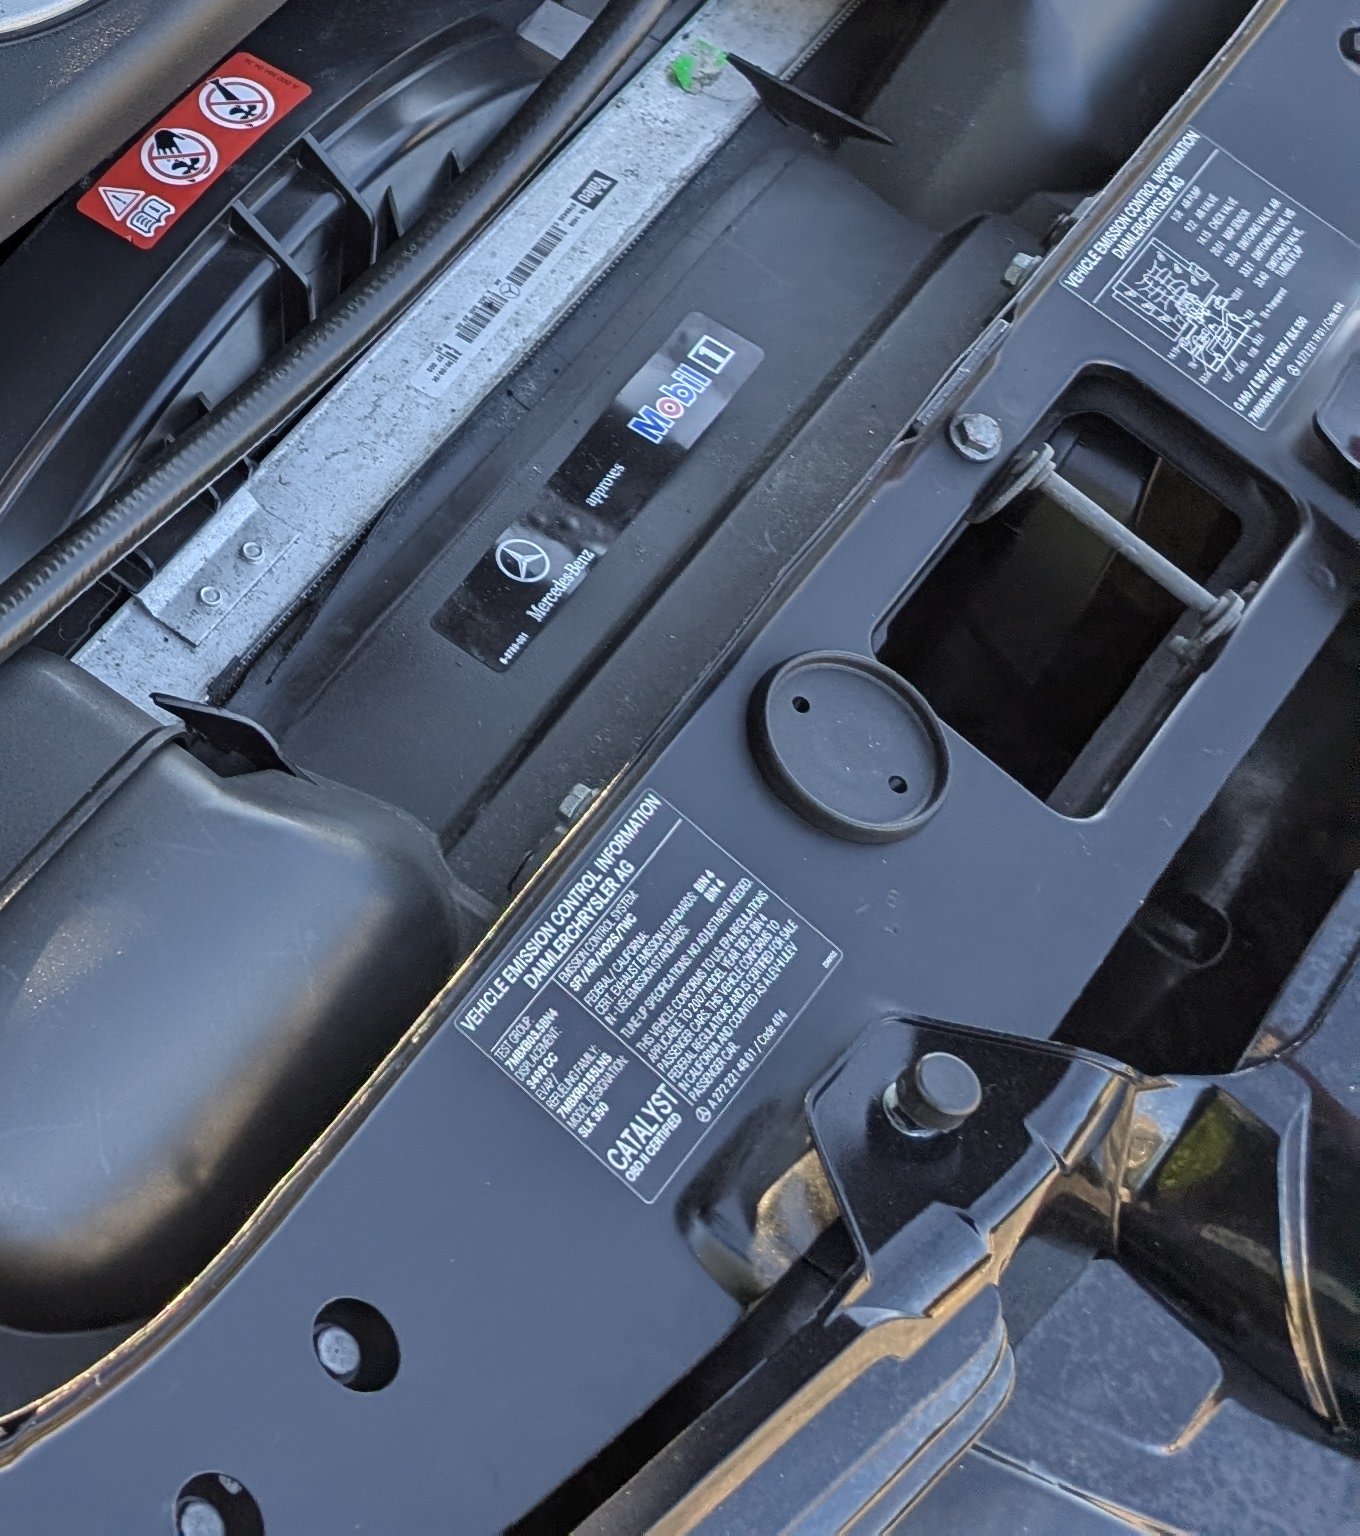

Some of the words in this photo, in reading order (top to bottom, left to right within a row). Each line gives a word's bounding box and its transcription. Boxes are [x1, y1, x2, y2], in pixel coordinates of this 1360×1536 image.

[576, 170, 613, 210] Valeo
[1064, 249, 1103, 288] VEHICLE
[1092, 212, 1133, 255] EMISSION
[1123, 180, 1161, 218] CONTROL
[1150, 129, 1201, 185] INFORMATION
[1111, 186, 1177, 260] DAIMLERCHRYSLER
[1167, 175, 1186, 192] AG
[627, 363, 713, 444] Mobil
[585, 462, 627, 507] approves
[525, 541, 598, 623] Mercedes-Benz
[459, 977, 511, 1032] VEHICLE
[501, 920, 558, 985] EMISSION
[550, 869, 603, 926] CONTROL
[593, 793, 663, 874] INFORMATION
[522, 876, 622, 990] DAIMLERCHRYSLER
[613, 859, 636, 883] AG
[748, 917, 766, 934] BIN
[758, 912, 769, 922] 4
[778, 918, 799, 941] SALE
[557, 947, 591, 984] EMISSION
[583, 918, 617, 953] CONTROL
[609, 889, 640, 922] SYSTEM:
[569, 912, 638, 992] SFI/AIR/HO2S/TWC
[594, 991, 617, 1016] CERT.
[609, 959, 642, 997] EXHAUST
[635, 929, 667, 966] EMISSION
[659, 891, 700, 936] STANDARDS:
[693, 874, 711, 894] BIN
[704, 869, 716, 879] 4
[603, 1012, 618, 1026] IN
[613, 994, 633, 1014] USE
[624, 963, 658, 1001] EMISSION
[650, 924, 691, 970] STANDARDS:
[703, 883, 722, 903] BIN
[715, 878, 727, 888] 4
[611, 930, 650, 973] CALIFORNIA:
[733, 934, 752, 952] TIER
[745, 928, 757, 940] 2
[768, 935, 787, 955] FOR
[619, 1005, 649, 1039] TUNE-UP
[685, 942, 702, 959] NO
[695, 900, 734, 948] ADJUSTMENT
[726, 877, 754, 907] NEEDED.
[635, 1033, 656, 1053] THIS
[647, 1004, 678, 1037] VEHICLE
[671, 967, 708, 1010] CONFORMS
[700, 957, 716, 973] TO
[718, 932, 737, 951] EPA
[728, 889, 770, 938] REGULATIONS
[719, 948, 742, 970] YEAR
[745, 949, 775, 984] CERTIFIED
[656, 1028, 696, 1074] PASSENGER
[689, 1008, 713, 1033] CARS.
[704, 992, 724, 1012] THIS
[716, 964, 746, 996] VEHICLE
[738, 929, 773, 971] CONFORMS
[765, 919, 781, 934] TO
[687, 988, 708, 1013] 2007
[701, 967, 728, 995] MODEL
[728, 987, 746, 1008] AND
[739, 980, 752, 992] IS
[677, 1008, 693, 1023] TO
[677, 1078, 691, 1093] IN
[684, 1040, 723, 1084] CALIFORNIA
[716, 1025, 734, 1046] AND
[727, 993, 759, 1030] COUNTED
[753, 982, 768, 998] AS
[778, 940, 799, 964] ULEV
[690, 1002, 734, 1053] REGULATIONS
[756, 1024, 777, 1046] Code
[771, 1008, 789, 1027] 494
[493, 1039, 514, 1062] TEST
[507, 1015, 535, 1044] GROUP:
[513, 1025, 563, 1082] DISPLACEMENT:
[647, 1017, 686, 1064] APPLICABLE
[743, 1047, 758, 1063] 01
[525, 1064, 548, 1090] 3498
[542, 1051, 559, 1069] CC
[545, 1070, 580, 1111] REFUELING
[572, 1044, 602, 1076] FAMILY:
[666, 1049, 699, 1083] FEDERAL
[687, 1056, 728, 1102] PASSENGER
[723, 1068, 742, 1088] 221
[565, 1101, 593, 1130] MODEL
[584, 1054, 630, 1106] DESIGNATION:
[706, 1098, 719, 1111] A
[711, 1083, 730, 1103] 272
[577, 1117, 597, 1138] SLK
[590, 1101, 610, 1122] 350
[606, 1082, 679, 1171] CATALYST
[644, 1112, 682, 1157] CERTIFIED
[624, 1159, 645, 1183] OBD
[639, 1152, 651, 1165] II
